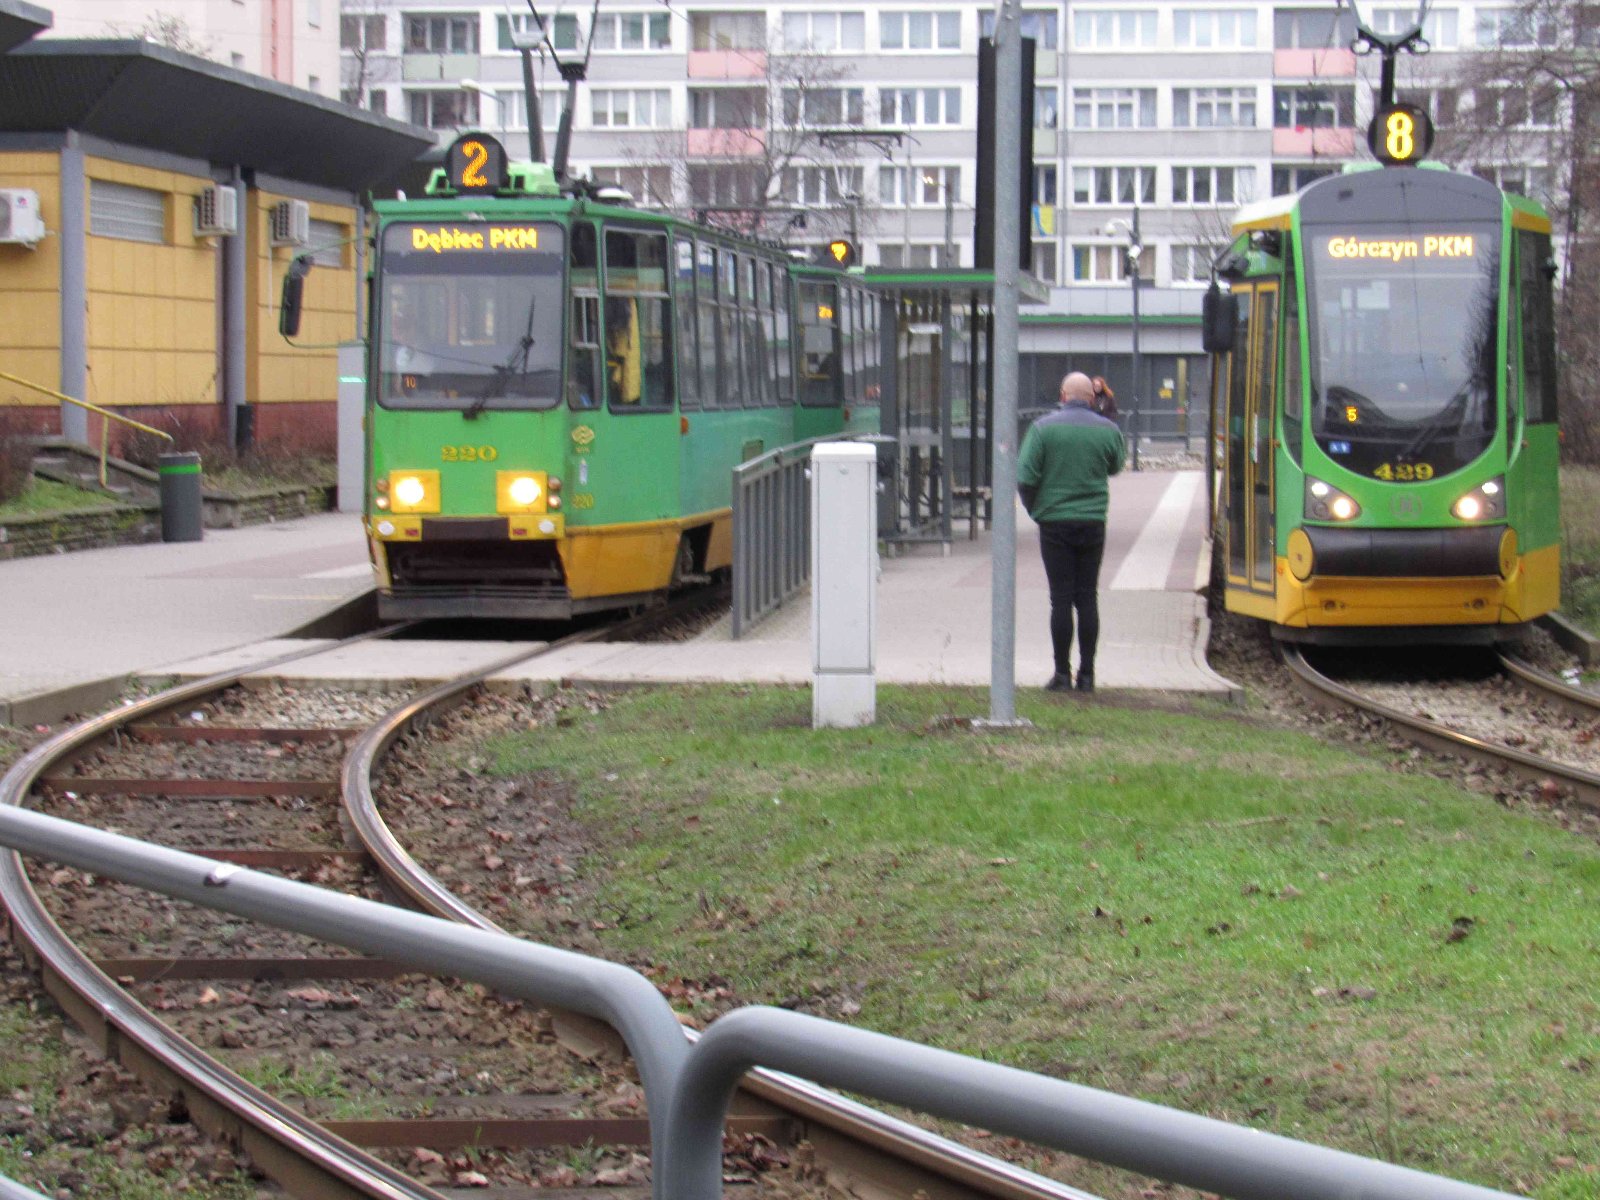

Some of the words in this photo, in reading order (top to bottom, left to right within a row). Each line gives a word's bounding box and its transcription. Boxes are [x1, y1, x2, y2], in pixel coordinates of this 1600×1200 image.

[1386, 111, 1413, 159] 8
[462, 140, 489, 187] 2
[412, 227, 484, 254] Dębiec
[490, 227, 537, 249] PKM
[1327, 236, 1418, 262] Górczyn
[1423, 235, 1474, 257] PKM
[1345, 405, 1358, 422] 5
